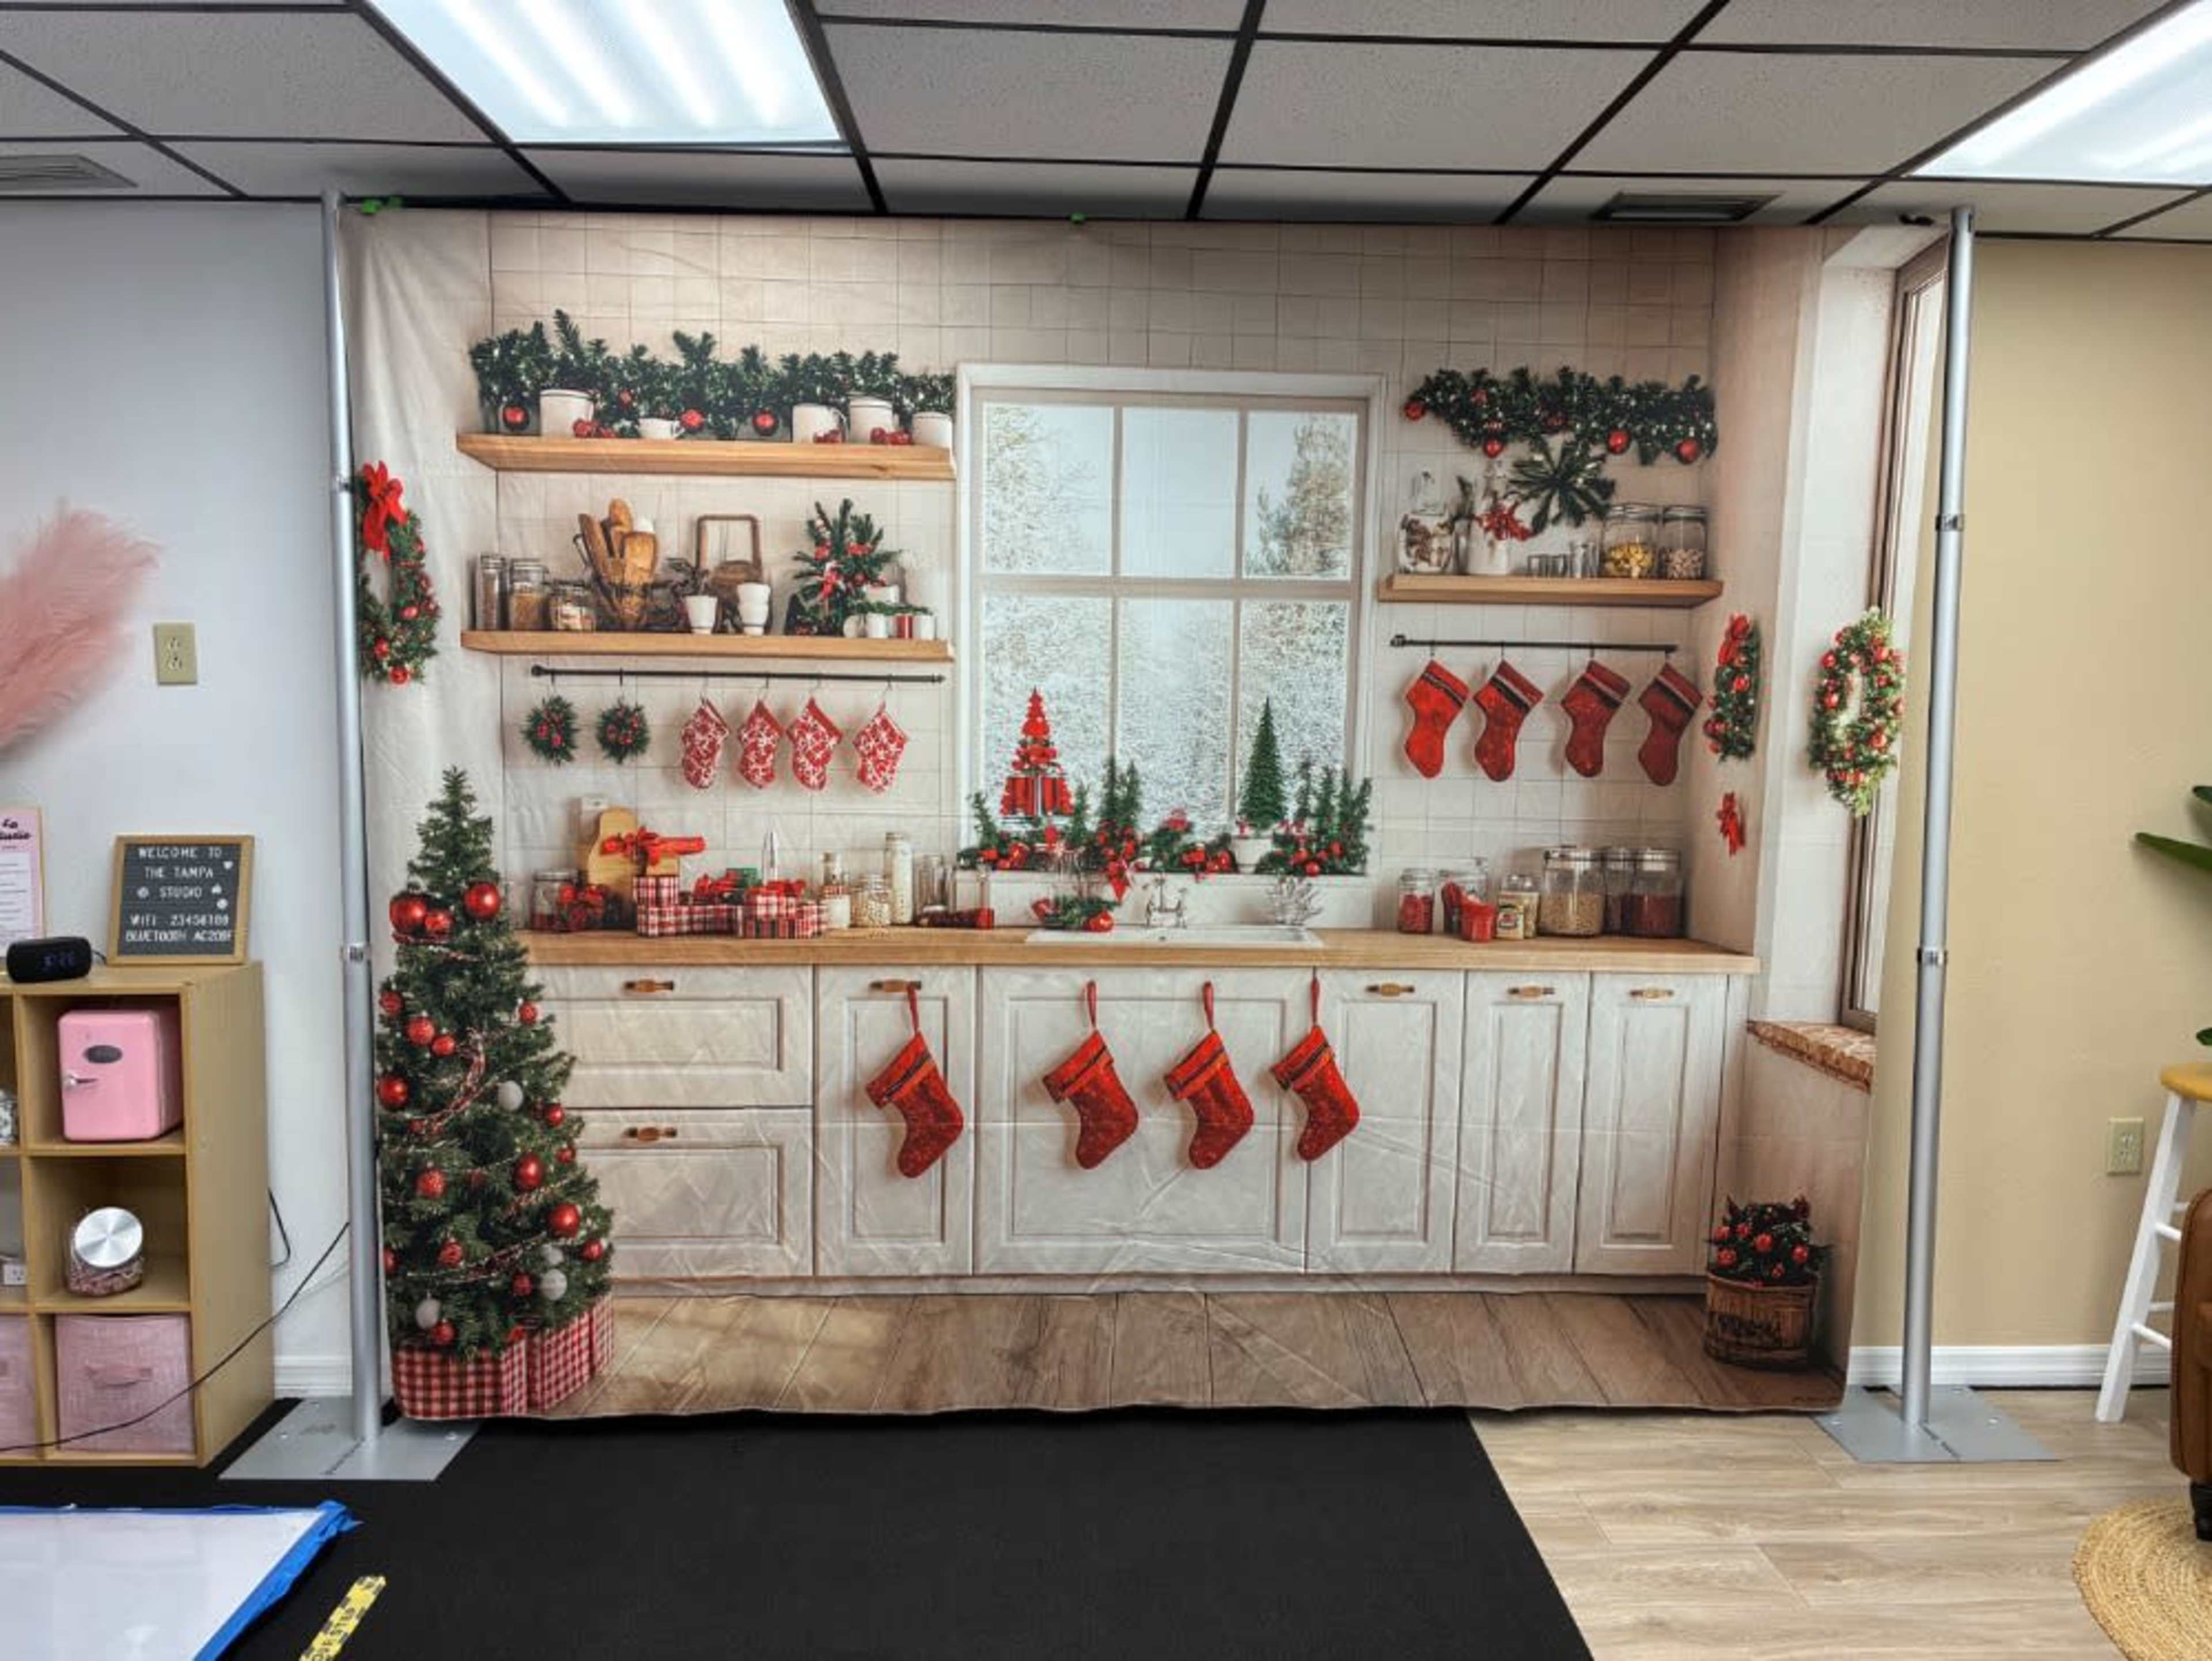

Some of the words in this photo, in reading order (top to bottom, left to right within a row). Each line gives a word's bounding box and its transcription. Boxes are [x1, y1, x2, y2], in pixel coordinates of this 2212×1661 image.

[138, 847, 198, 858] WELCOME
[208, 847, 222, 858] TO
[145, 867, 165, 879] THE
[175, 867, 213, 878] TAMPA
[159, 886, 202, 898] STUDIO
[130, 914, 156, 926] WIFI
[126, 929, 187, 942] BLUETOOTH
